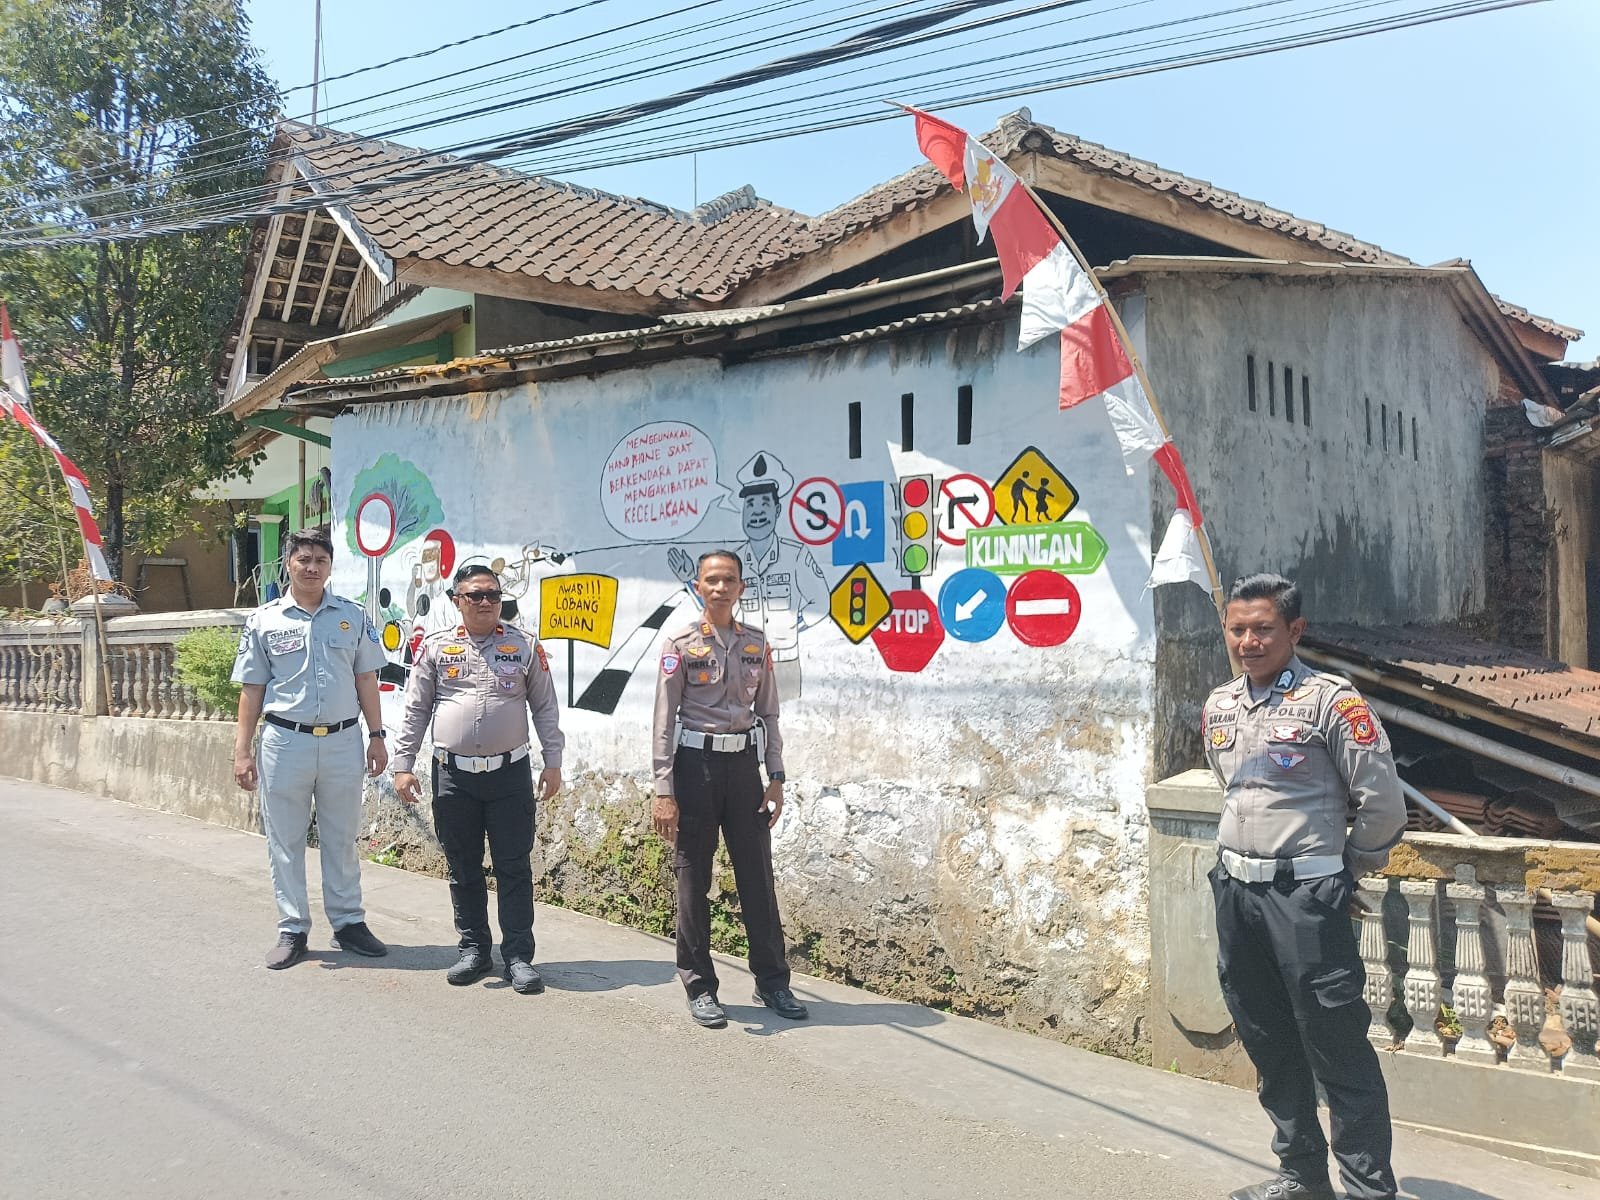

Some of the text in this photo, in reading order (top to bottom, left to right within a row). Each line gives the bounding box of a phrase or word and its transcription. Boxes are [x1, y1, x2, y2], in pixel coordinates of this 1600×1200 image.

[667, 442, 694, 458] SAAT
[609, 457, 709, 494] BERKENDARA DAPAT
[624, 476, 709, 504] MENGAKIBATKAN
[624, 498, 699, 524] KECELAKAAN
[971, 533, 1084, 568] KUNINGAN
[556, 596, 599, 613] LOBANG
[550, 613, 594, 632] GALIAN
[440, 655, 467, 664] ALFAN
[494, 654, 522, 663] POLRI
[1268, 706, 1314, 719] POLRI
